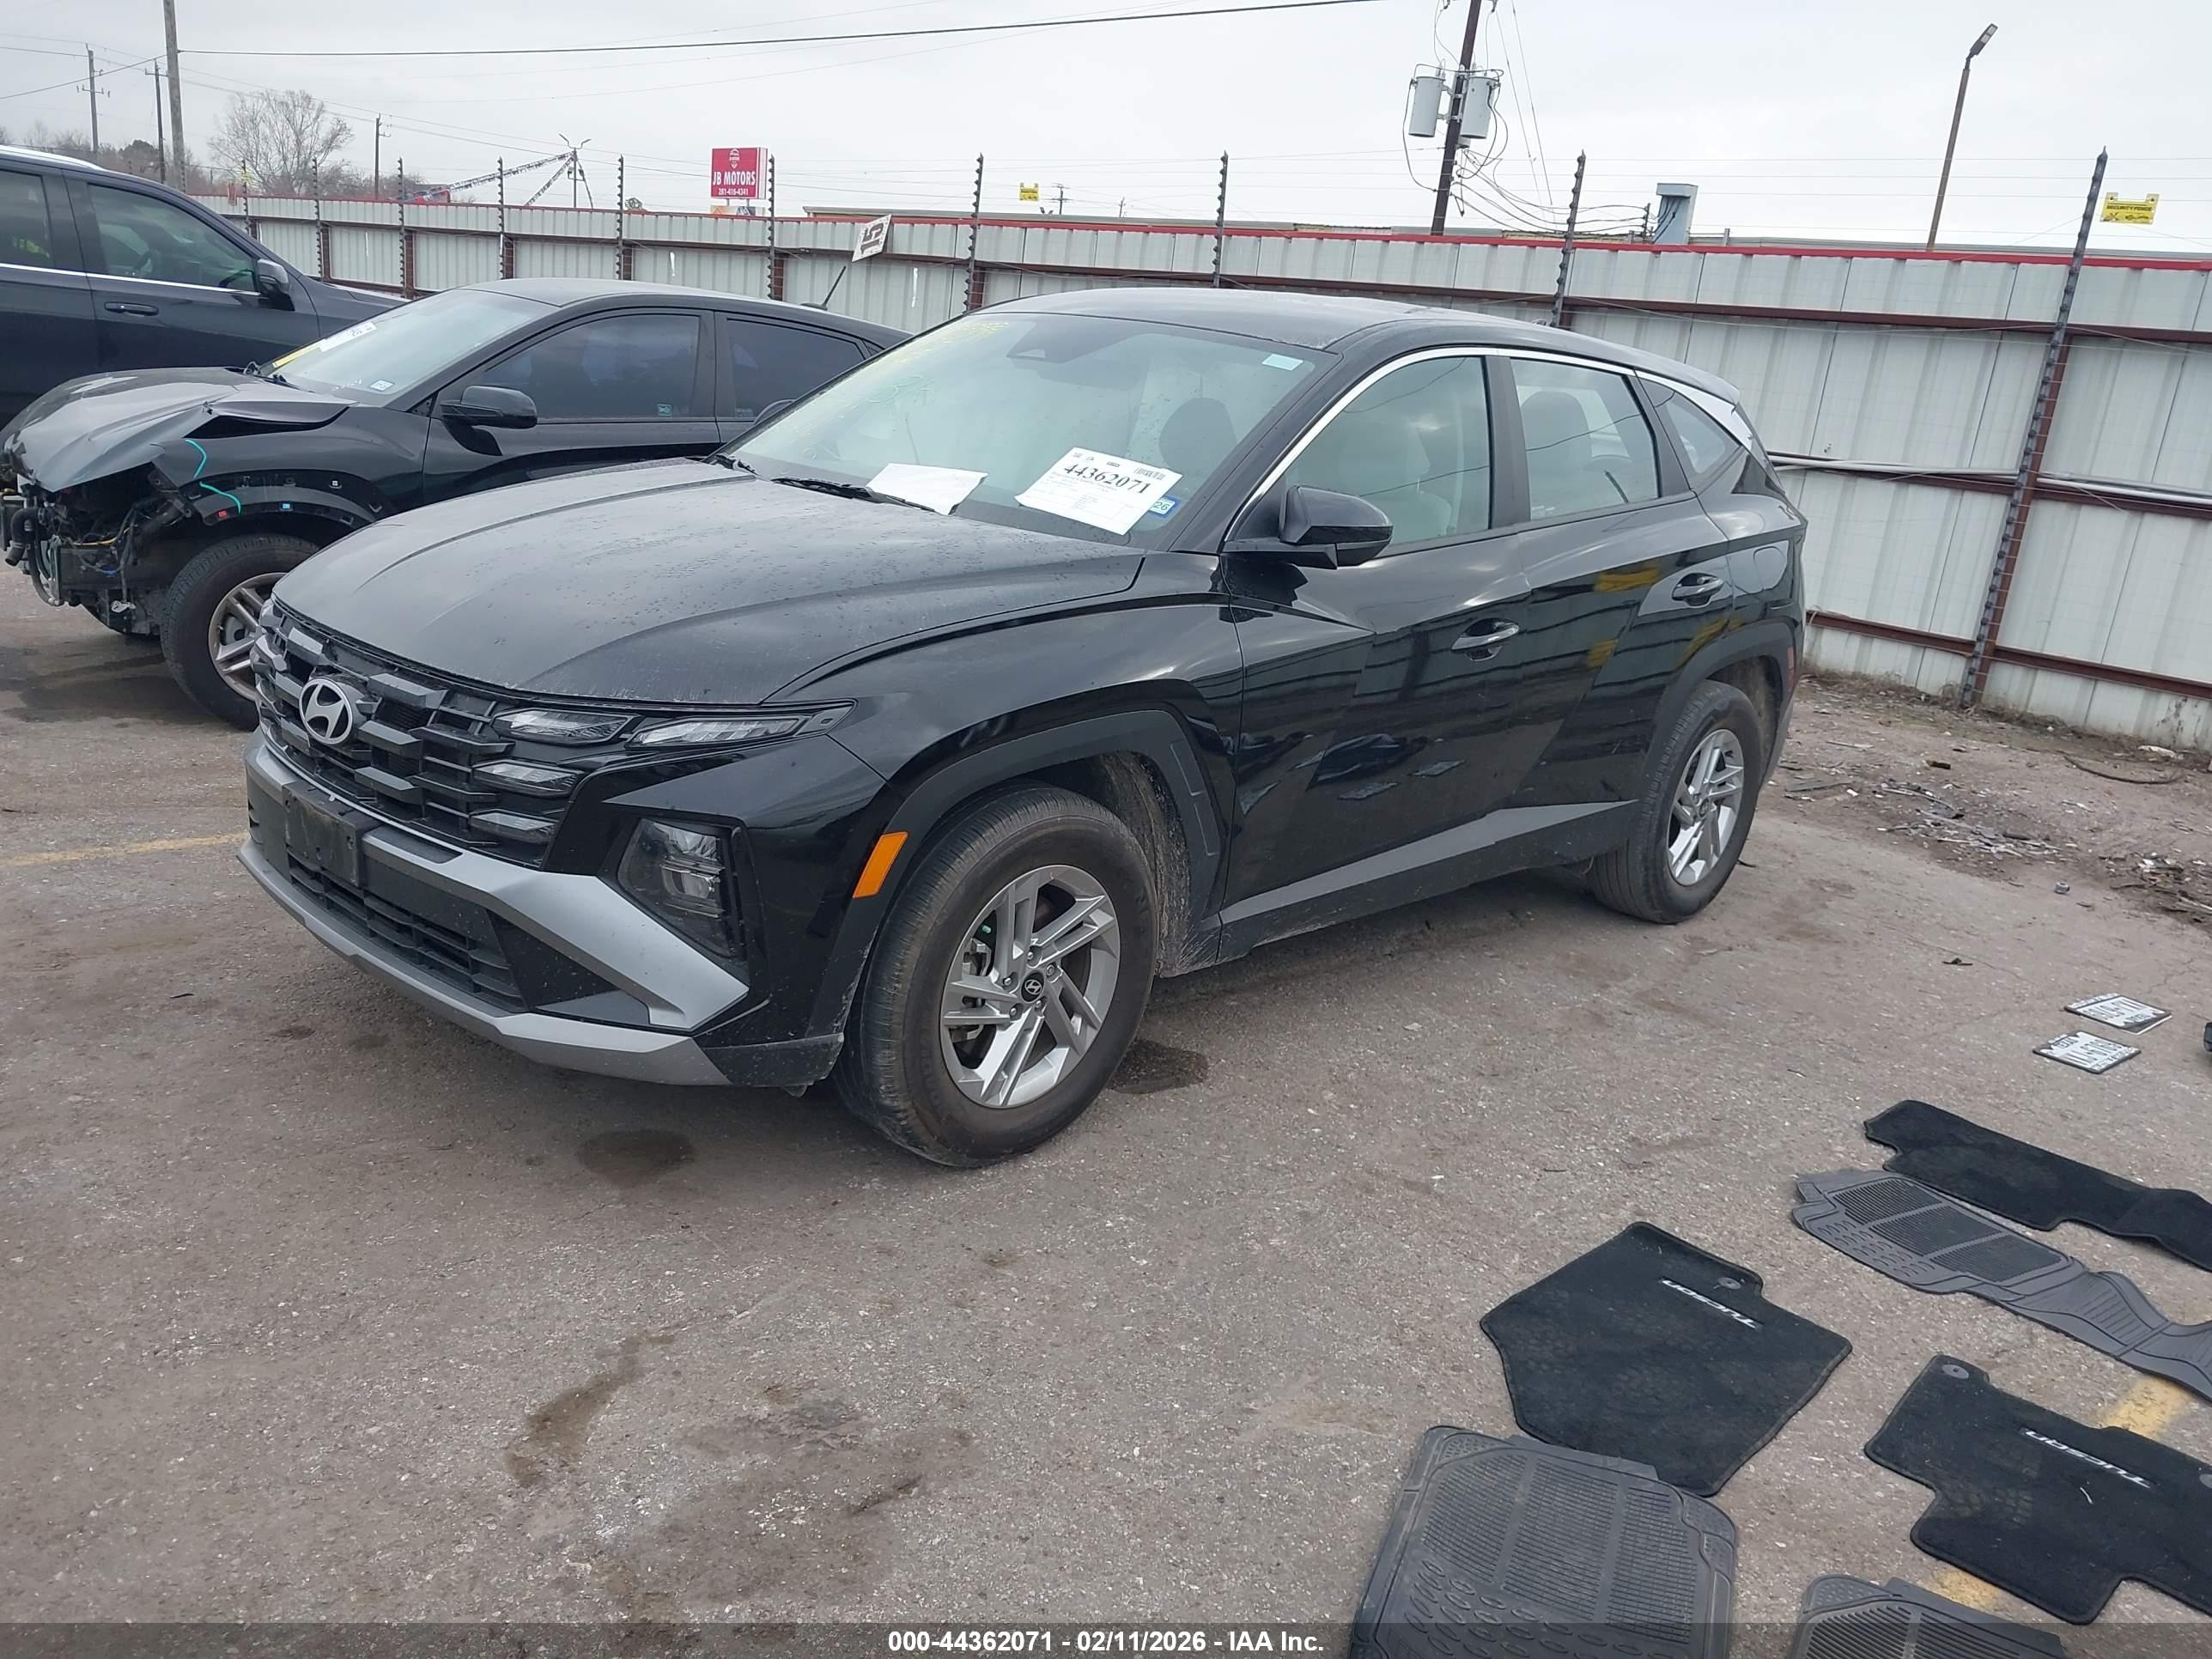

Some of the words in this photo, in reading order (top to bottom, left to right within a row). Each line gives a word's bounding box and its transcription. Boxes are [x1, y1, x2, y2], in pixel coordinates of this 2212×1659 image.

[712, 171, 722, 185] JB
[724, 171, 756, 185] MOTORS
[1064, 464, 1151, 494] 44362071
[1154, 501, 1170, 511] 26
